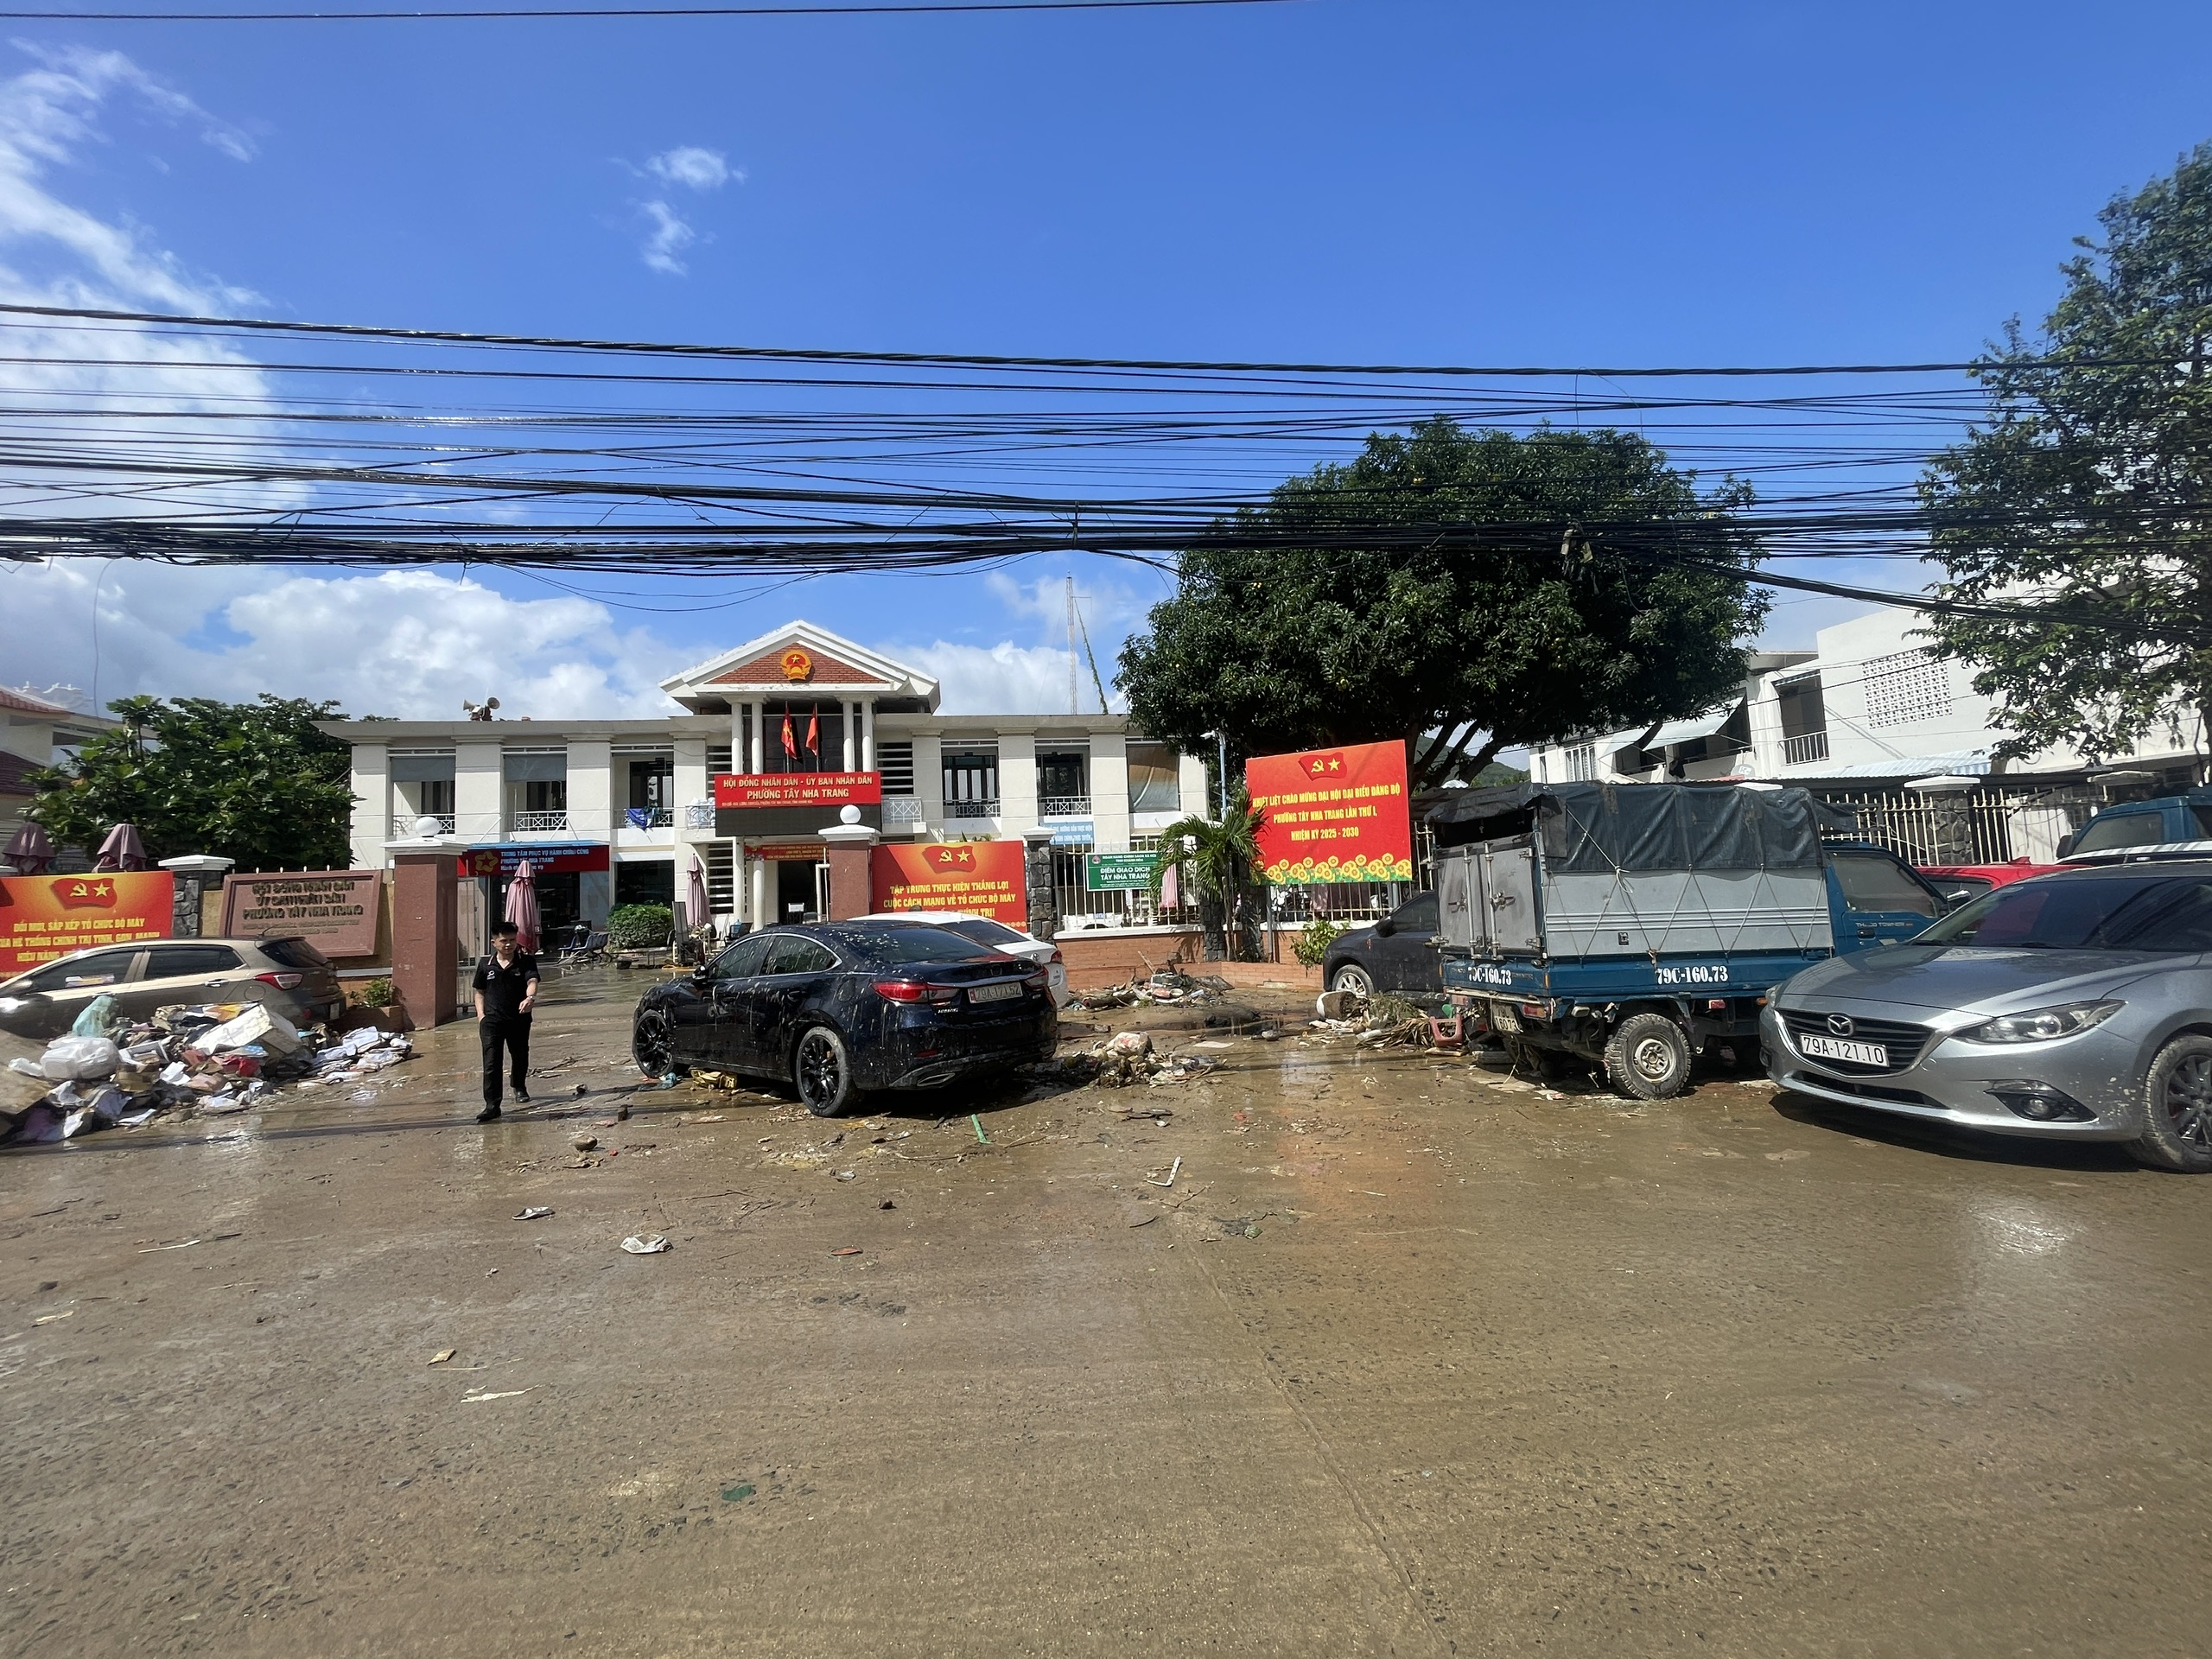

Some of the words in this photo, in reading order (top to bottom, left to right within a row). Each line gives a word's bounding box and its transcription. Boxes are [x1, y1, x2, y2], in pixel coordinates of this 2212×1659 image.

[723, 778, 736, 790] HỘI
[739, 776, 759, 787] ĐỒNG
[761, 777, 781, 786] NHÂN
[784, 777, 798, 786] DÂN
[806, 775, 816, 785] ỦY
[836, 776, 855, 785] NHÂN
[857, 775, 873, 785] DÂN
[747, 788, 780, 799] PHƯỜNG
[783, 788, 799, 798] TÂY
[802, 789, 819, 798] NHA
[822, 788, 849, 798] TRANG
[1269, 794, 1281, 807] LIỆT
[1282, 792, 1298, 804] CHÀO
[1300, 791, 1317, 803] MỪNG
[1319, 791, 1329, 802] ĐẠI
[1330, 788, 1341, 801] HỘI
[1355, 784, 1370, 798] BIỂU
[1390, 782, 1401, 796] BỘ
[1274, 811, 1297, 823] PHƯỜNG
[1299, 810, 1309, 822] TÂY
[1311, 810, 1324, 821] NHA
[1324, 809, 1344, 820] TRANG
[1345, 805, 1357, 818] LẦN
[1358, 804, 1372, 817] THỨ
[1291, 829, 1310, 842] NHIỆM
[1320, 828, 1337, 839] 2025
[1342, 826, 1359, 838] 2030
[890, 885, 904, 895] TẬP
[906, 885, 931, 893] TRUNG
[932, 883, 950, 893] THỰC
[953, 881, 969, 893] HIỆN
[971, 879, 995, 891] THẮNG
[997, 880, 1008, 891] LỢI
[883, 898, 902, 909] CUỘC
[903, 897, 922, 907] CÁCH
[923, 897, 945, 907] MẠNG
[947, 893, 957, 906] VỀ
[957, 893, 967, 904] TỔ
[969, 893, 987, 904] CHỨC
[988, 893, 998, 904] BỘ
[1000, 892, 1015, 903] MÁY
[1656, 965, 1729, 985] 79C-160.73
[1803, 1037, 1885, 1064] 79A-121.10
